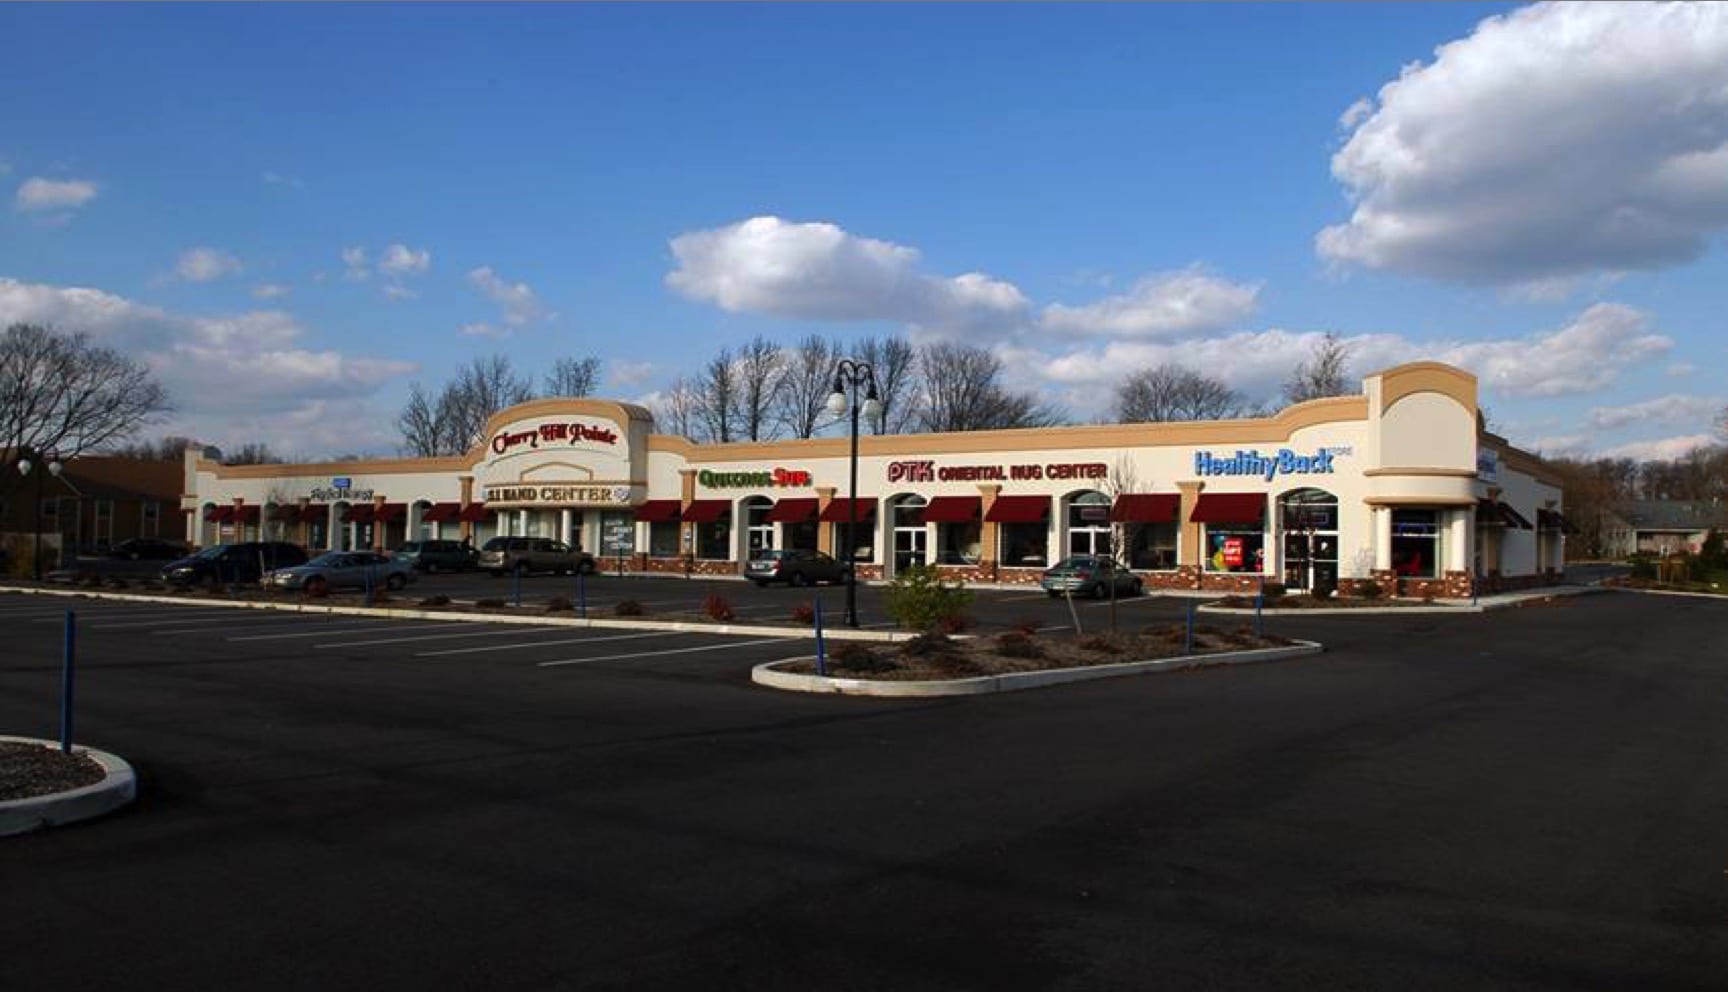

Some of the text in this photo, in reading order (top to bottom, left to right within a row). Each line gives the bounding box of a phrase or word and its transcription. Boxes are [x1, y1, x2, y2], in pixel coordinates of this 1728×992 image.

[492, 423, 618, 455] Cherry Hill Pointe
[888, 461, 1108, 482] PTK ORIENTAL RUG CENTER
[540, 487, 611, 501] CENTER
